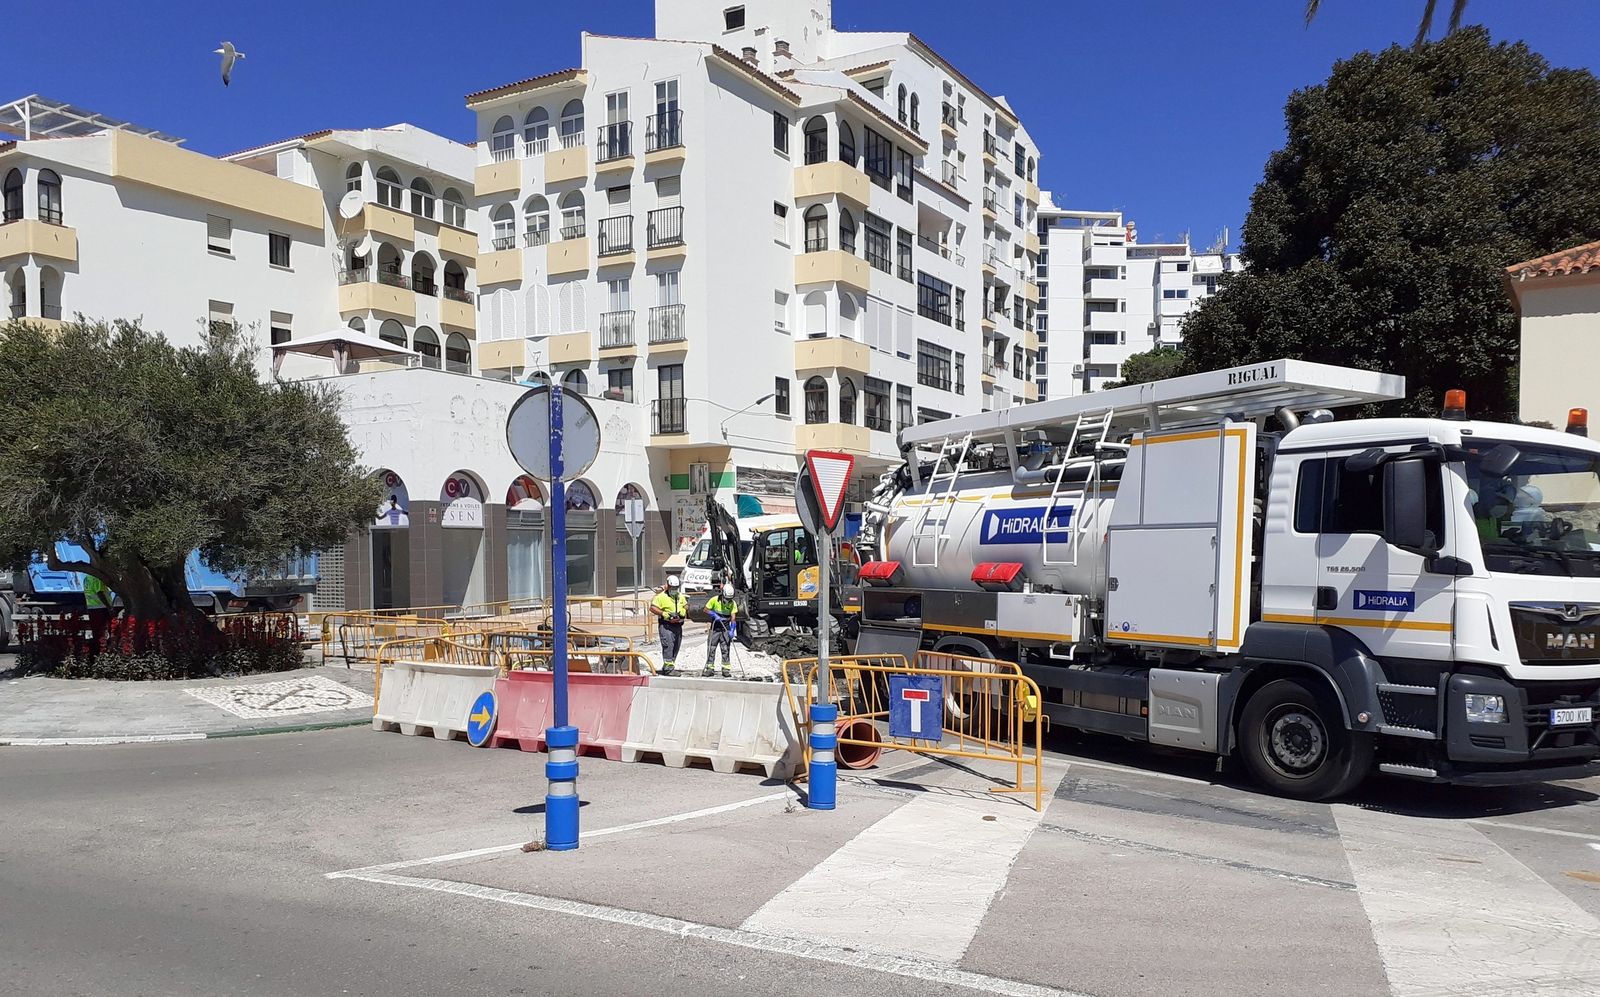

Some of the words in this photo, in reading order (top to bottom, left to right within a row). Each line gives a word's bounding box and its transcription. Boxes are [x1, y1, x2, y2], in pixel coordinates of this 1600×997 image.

[1227, 366, 1278, 386] RIGUAL
[447, 482, 468, 494] CV
[1546, 632, 1595, 650] MAN
[1158, 703, 1196, 719] MAN
[1556, 710, 1575, 723] 5700
